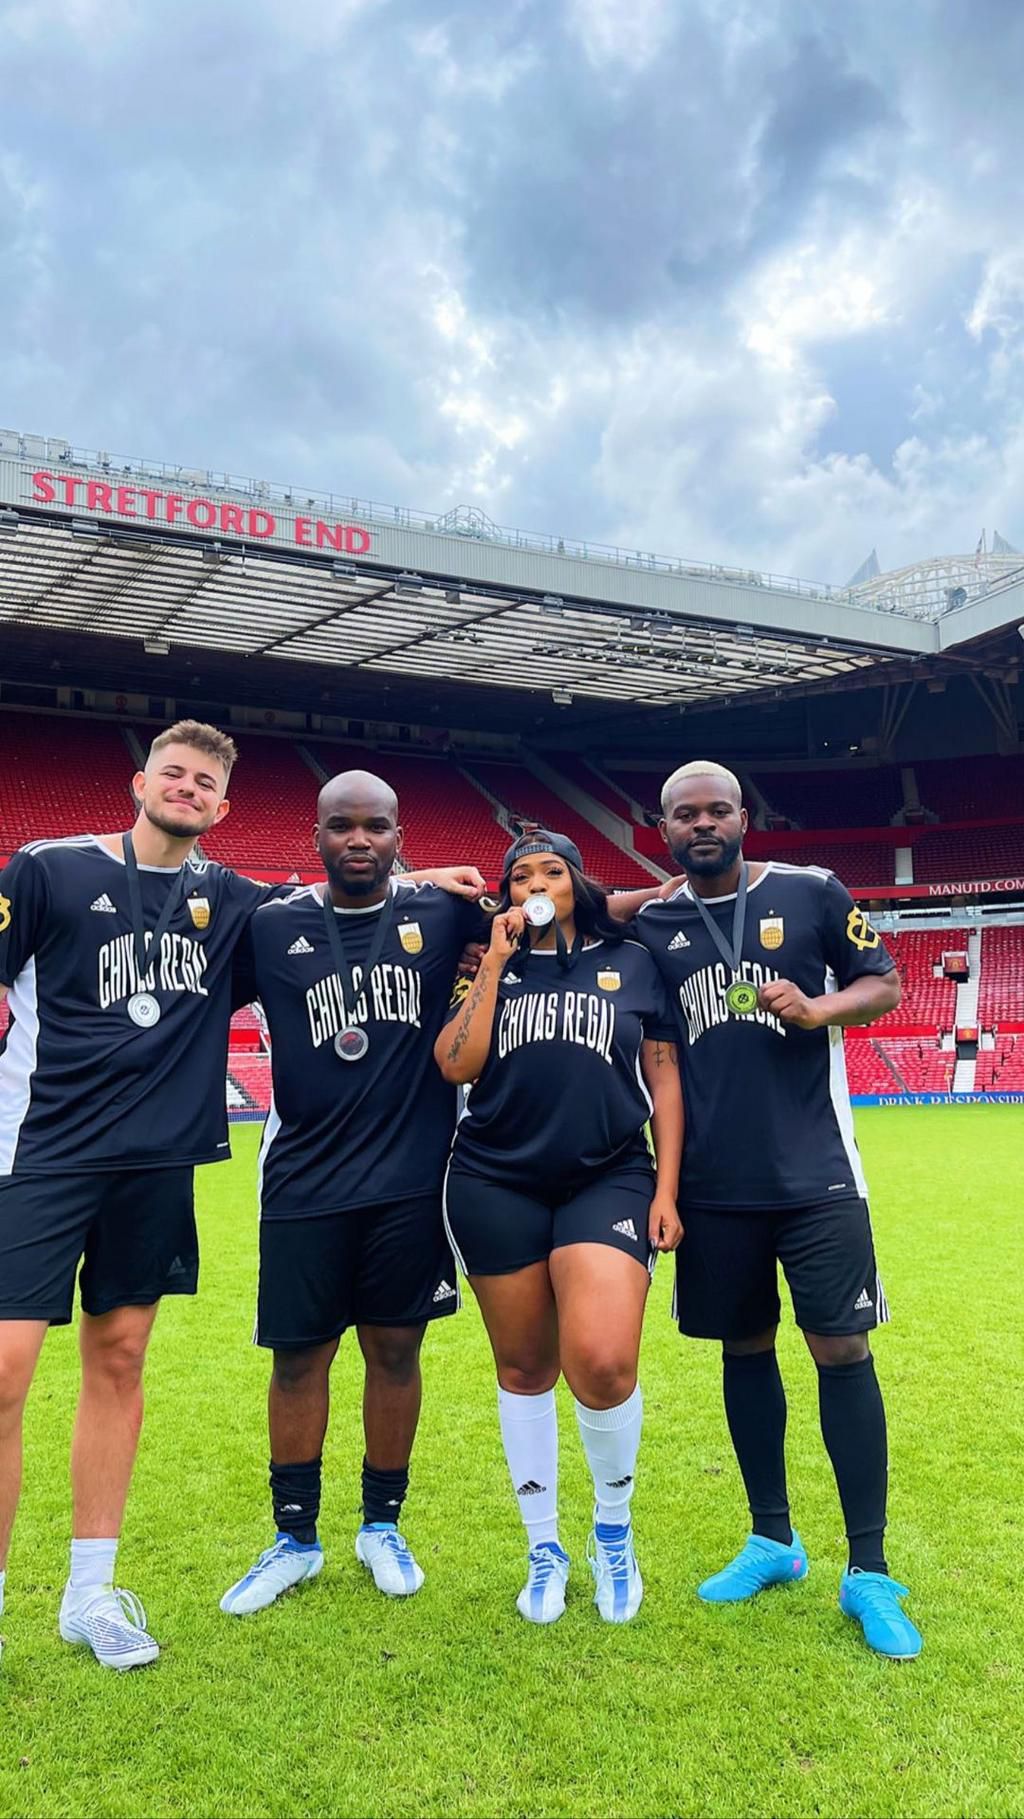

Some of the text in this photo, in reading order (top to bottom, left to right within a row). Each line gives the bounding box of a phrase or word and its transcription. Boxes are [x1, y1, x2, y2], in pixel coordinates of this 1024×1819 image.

[32, 471, 371, 555] STRETFORD END
[929, 880, 1024, 896] MANUTD.COM
[160, 932, 209, 996] REGAL
[667, 940, 691, 951] adidas
[370, 963, 422, 1029] REGAL
[499, 992, 559, 1059] CHIVAS
[562, 991, 615, 1066] REGAL
[680, 962, 730, 1046] CHIVAS
